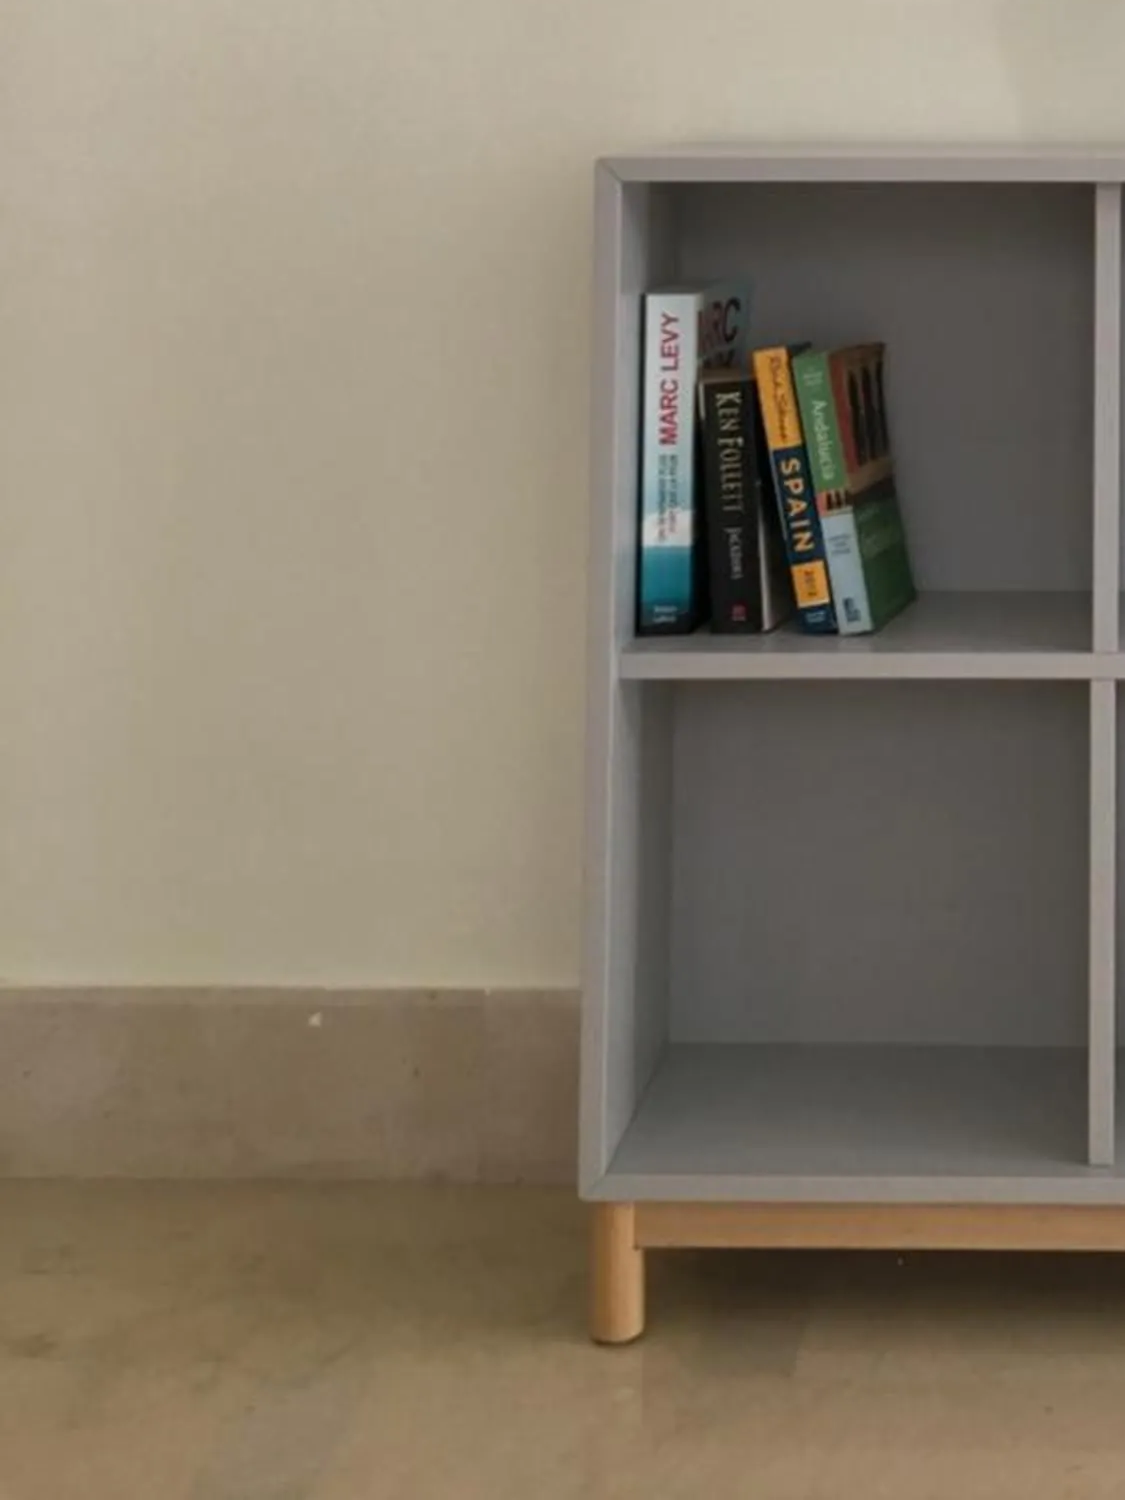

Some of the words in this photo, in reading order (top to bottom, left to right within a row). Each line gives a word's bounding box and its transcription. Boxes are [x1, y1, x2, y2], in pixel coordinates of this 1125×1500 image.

[661, 312, 679, 371] LEVY
[659, 379, 678, 446] MARC
[716, 391, 743, 431] KEN
[717, 436, 744, 512] FOLLETT
[780, 457, 815, 553] SPAIN
